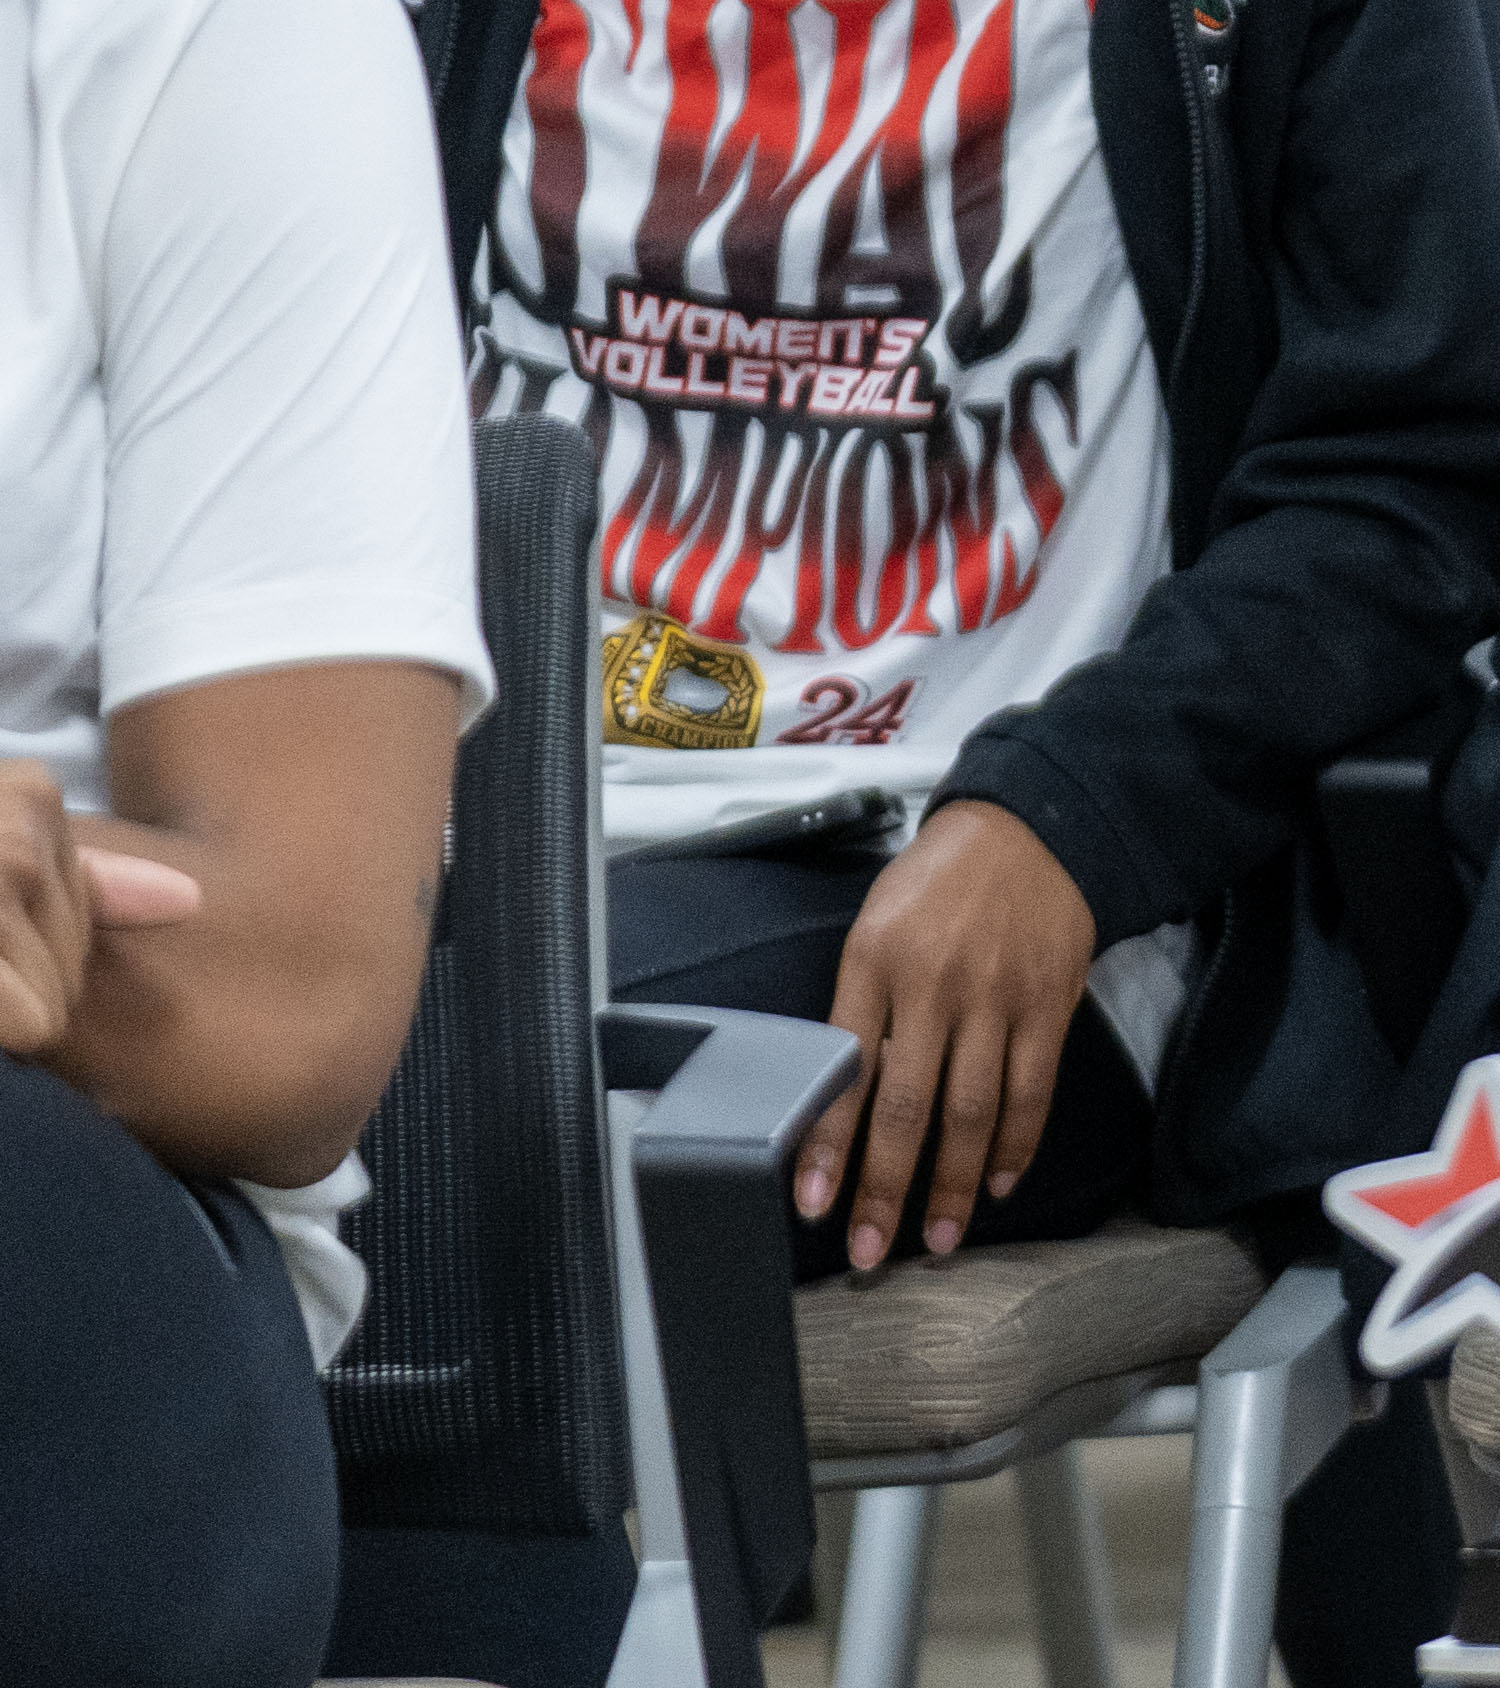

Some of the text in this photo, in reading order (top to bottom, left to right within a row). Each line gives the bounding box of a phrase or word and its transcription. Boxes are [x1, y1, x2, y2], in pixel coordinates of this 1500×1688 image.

[616, 288, 930, 366] WOMEN'S
[570, 326, 937, 419] VOLLEYBALL
[776, 674, 926, 746] 24
